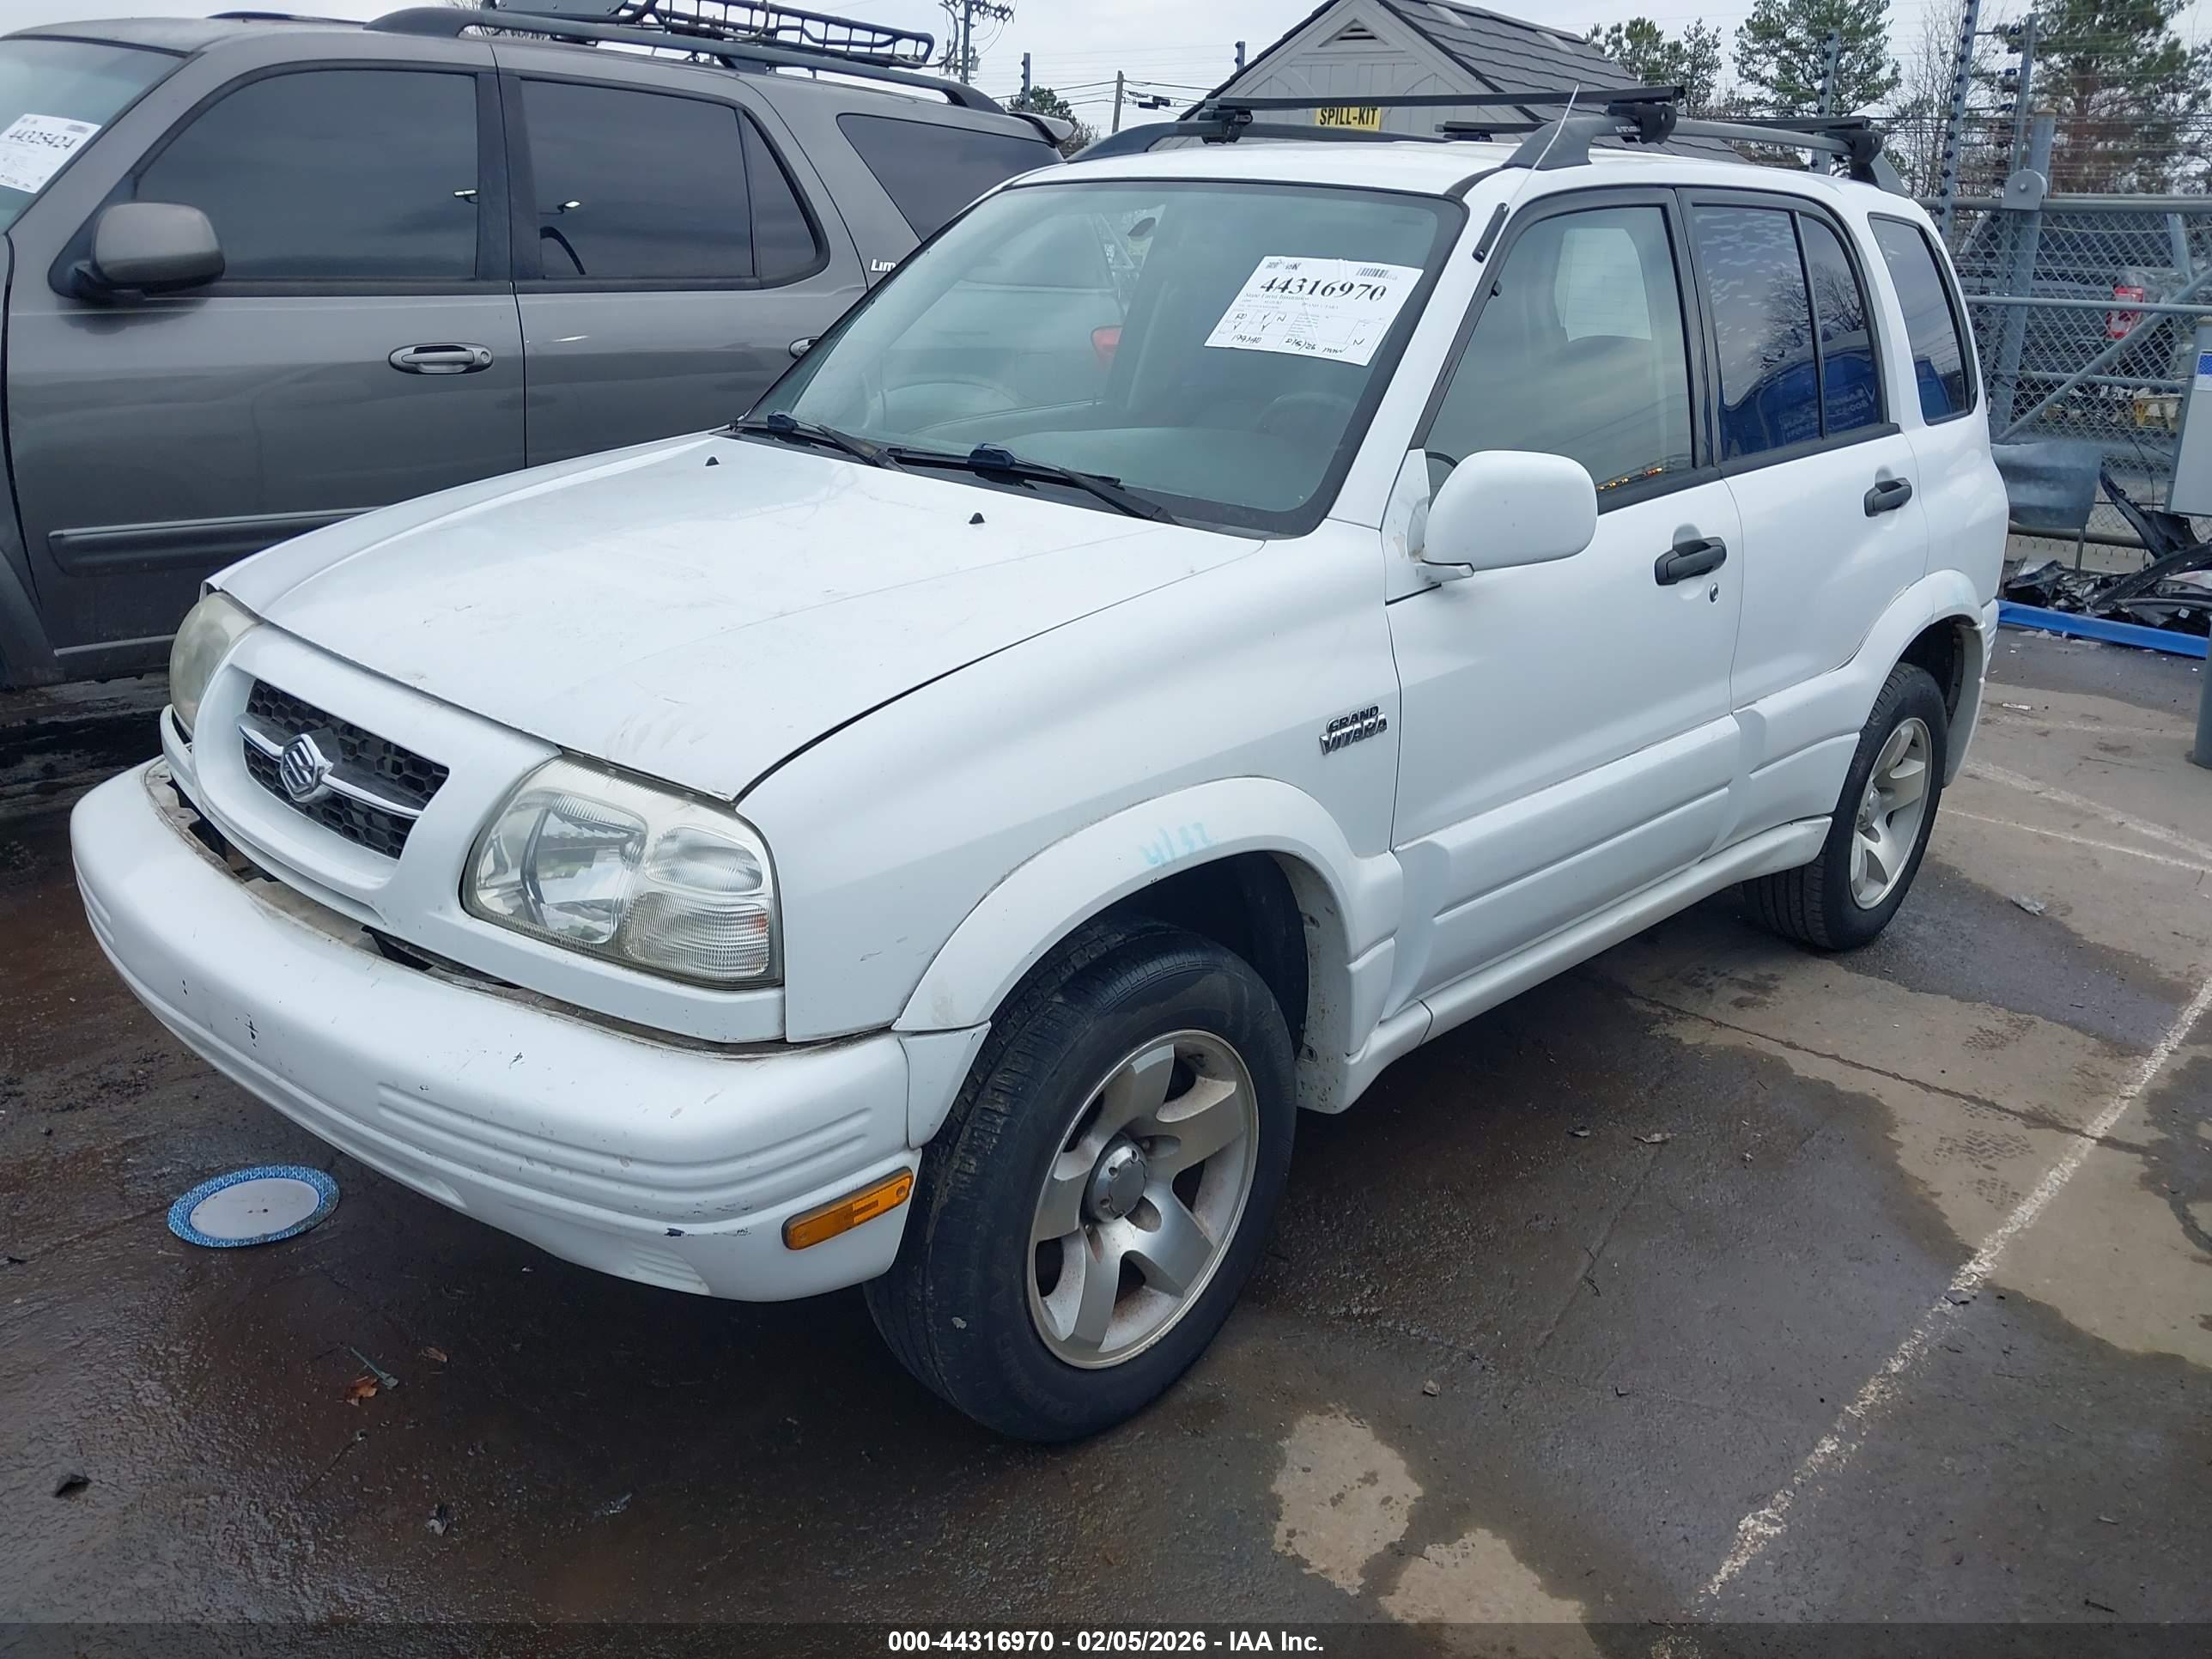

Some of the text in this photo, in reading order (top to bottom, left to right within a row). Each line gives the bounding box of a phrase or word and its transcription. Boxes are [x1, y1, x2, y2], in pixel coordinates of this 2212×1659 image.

[1319, 108, 1378, 126] SPILL-KIT
[1260, 276, 1388, 302] 44316970
[1326, 705, 1379, 733] GRAND
[1319, 714, 1388, 756] VITARA
